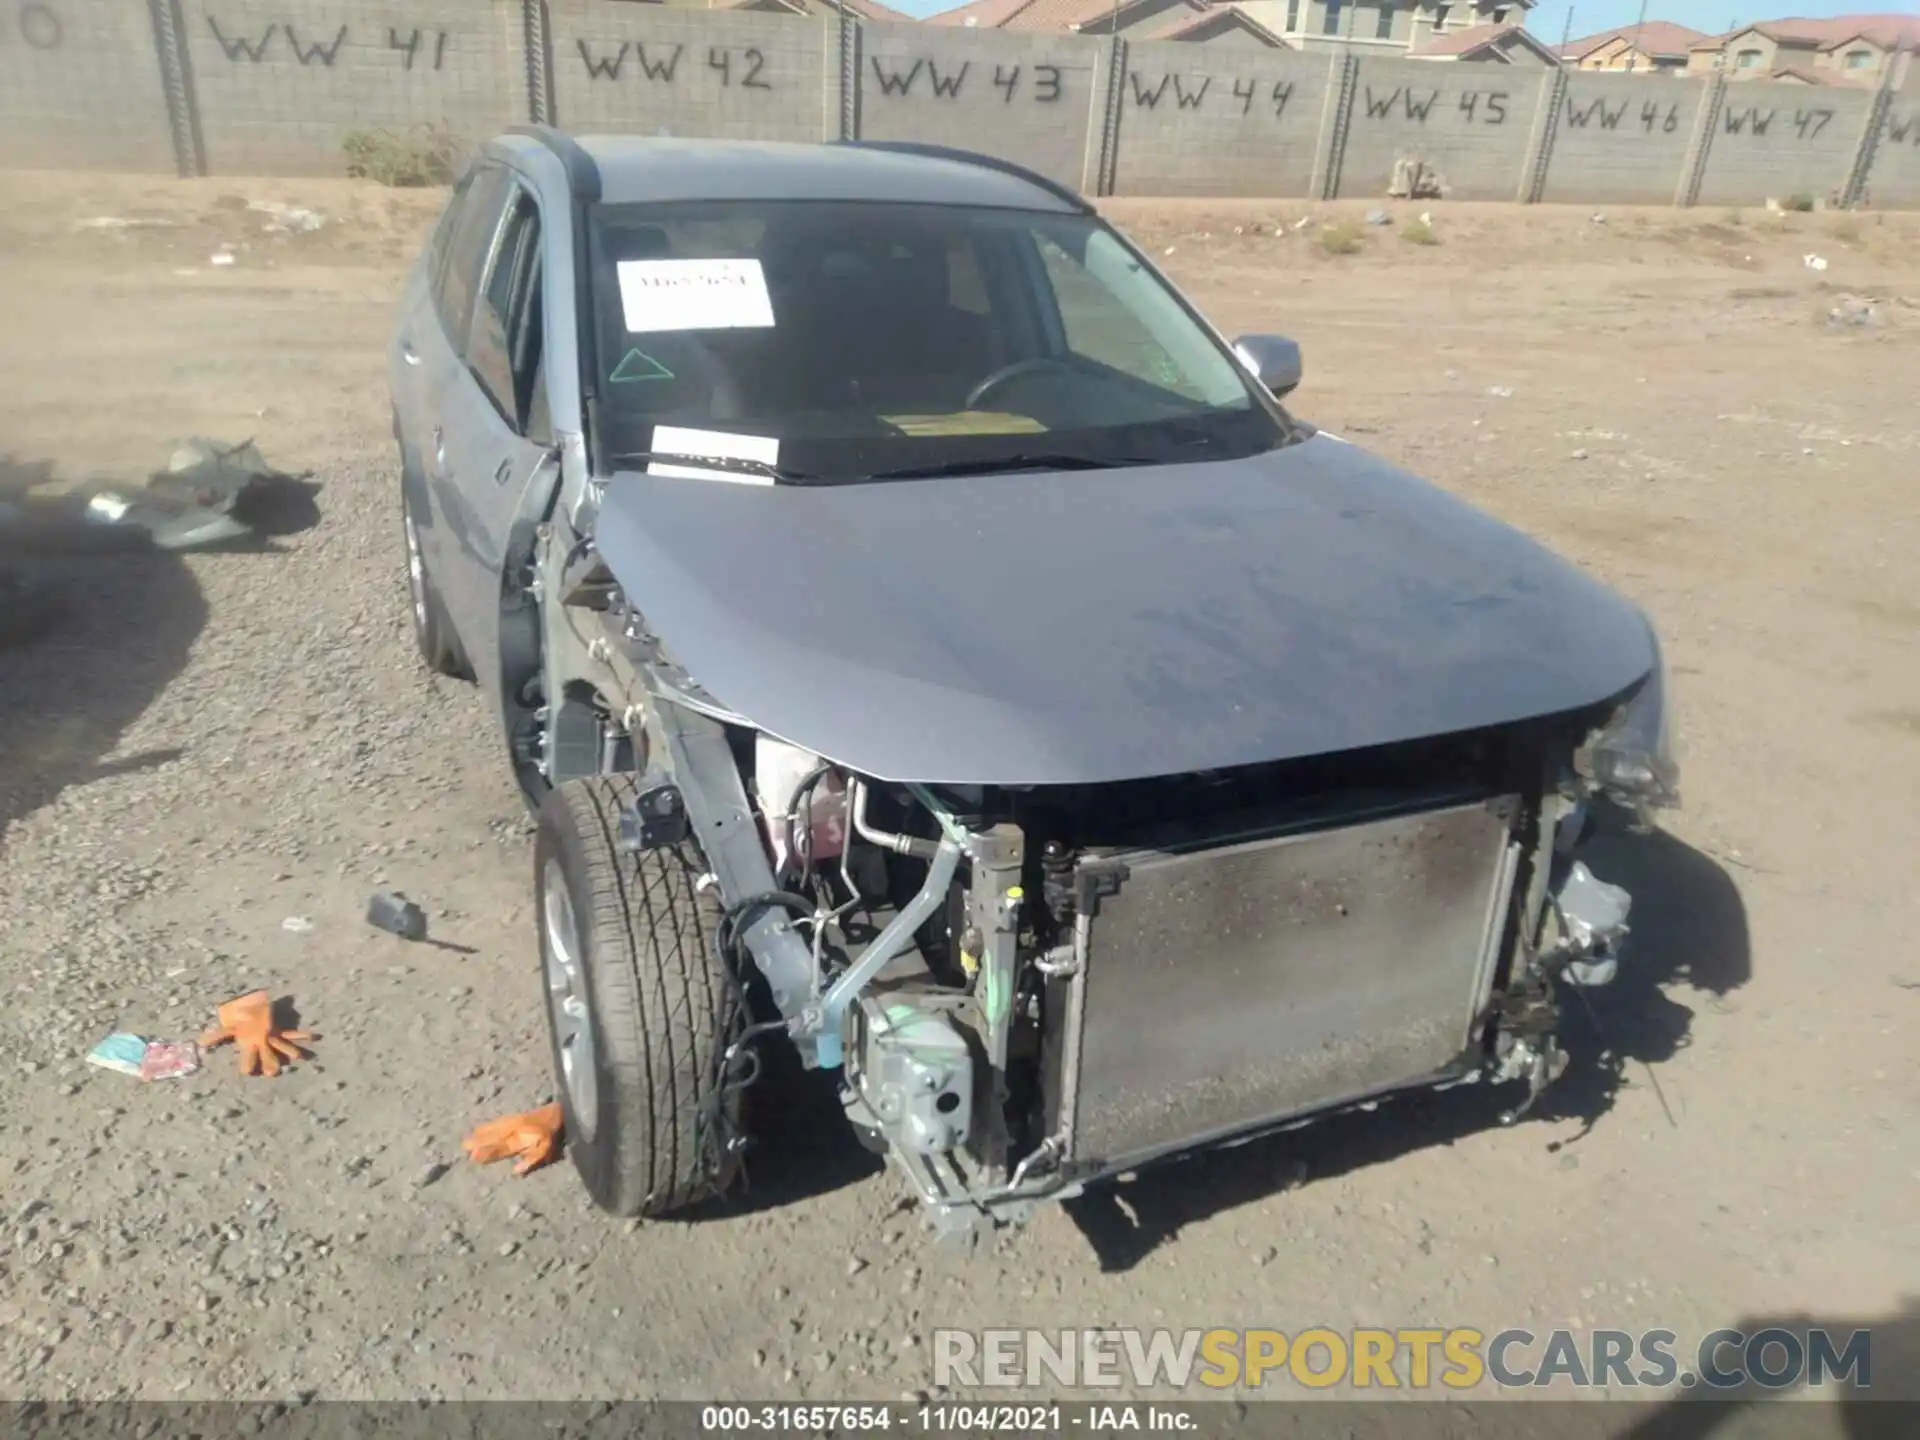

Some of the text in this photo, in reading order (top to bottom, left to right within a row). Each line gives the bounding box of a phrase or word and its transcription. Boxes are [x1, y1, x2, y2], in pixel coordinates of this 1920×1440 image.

[207, 16, 446, 70] WW 41
[577, 39, 771, 89] WW 42
[872, 56, 1060, 103] WW 43
[1131, 73, 1293, 116] WW 44
[1366, 85, 1508, 125] WW 45
[1568, 97, 1677, 133] WW 46
[1726, 107, 1836, 139] WW 47
